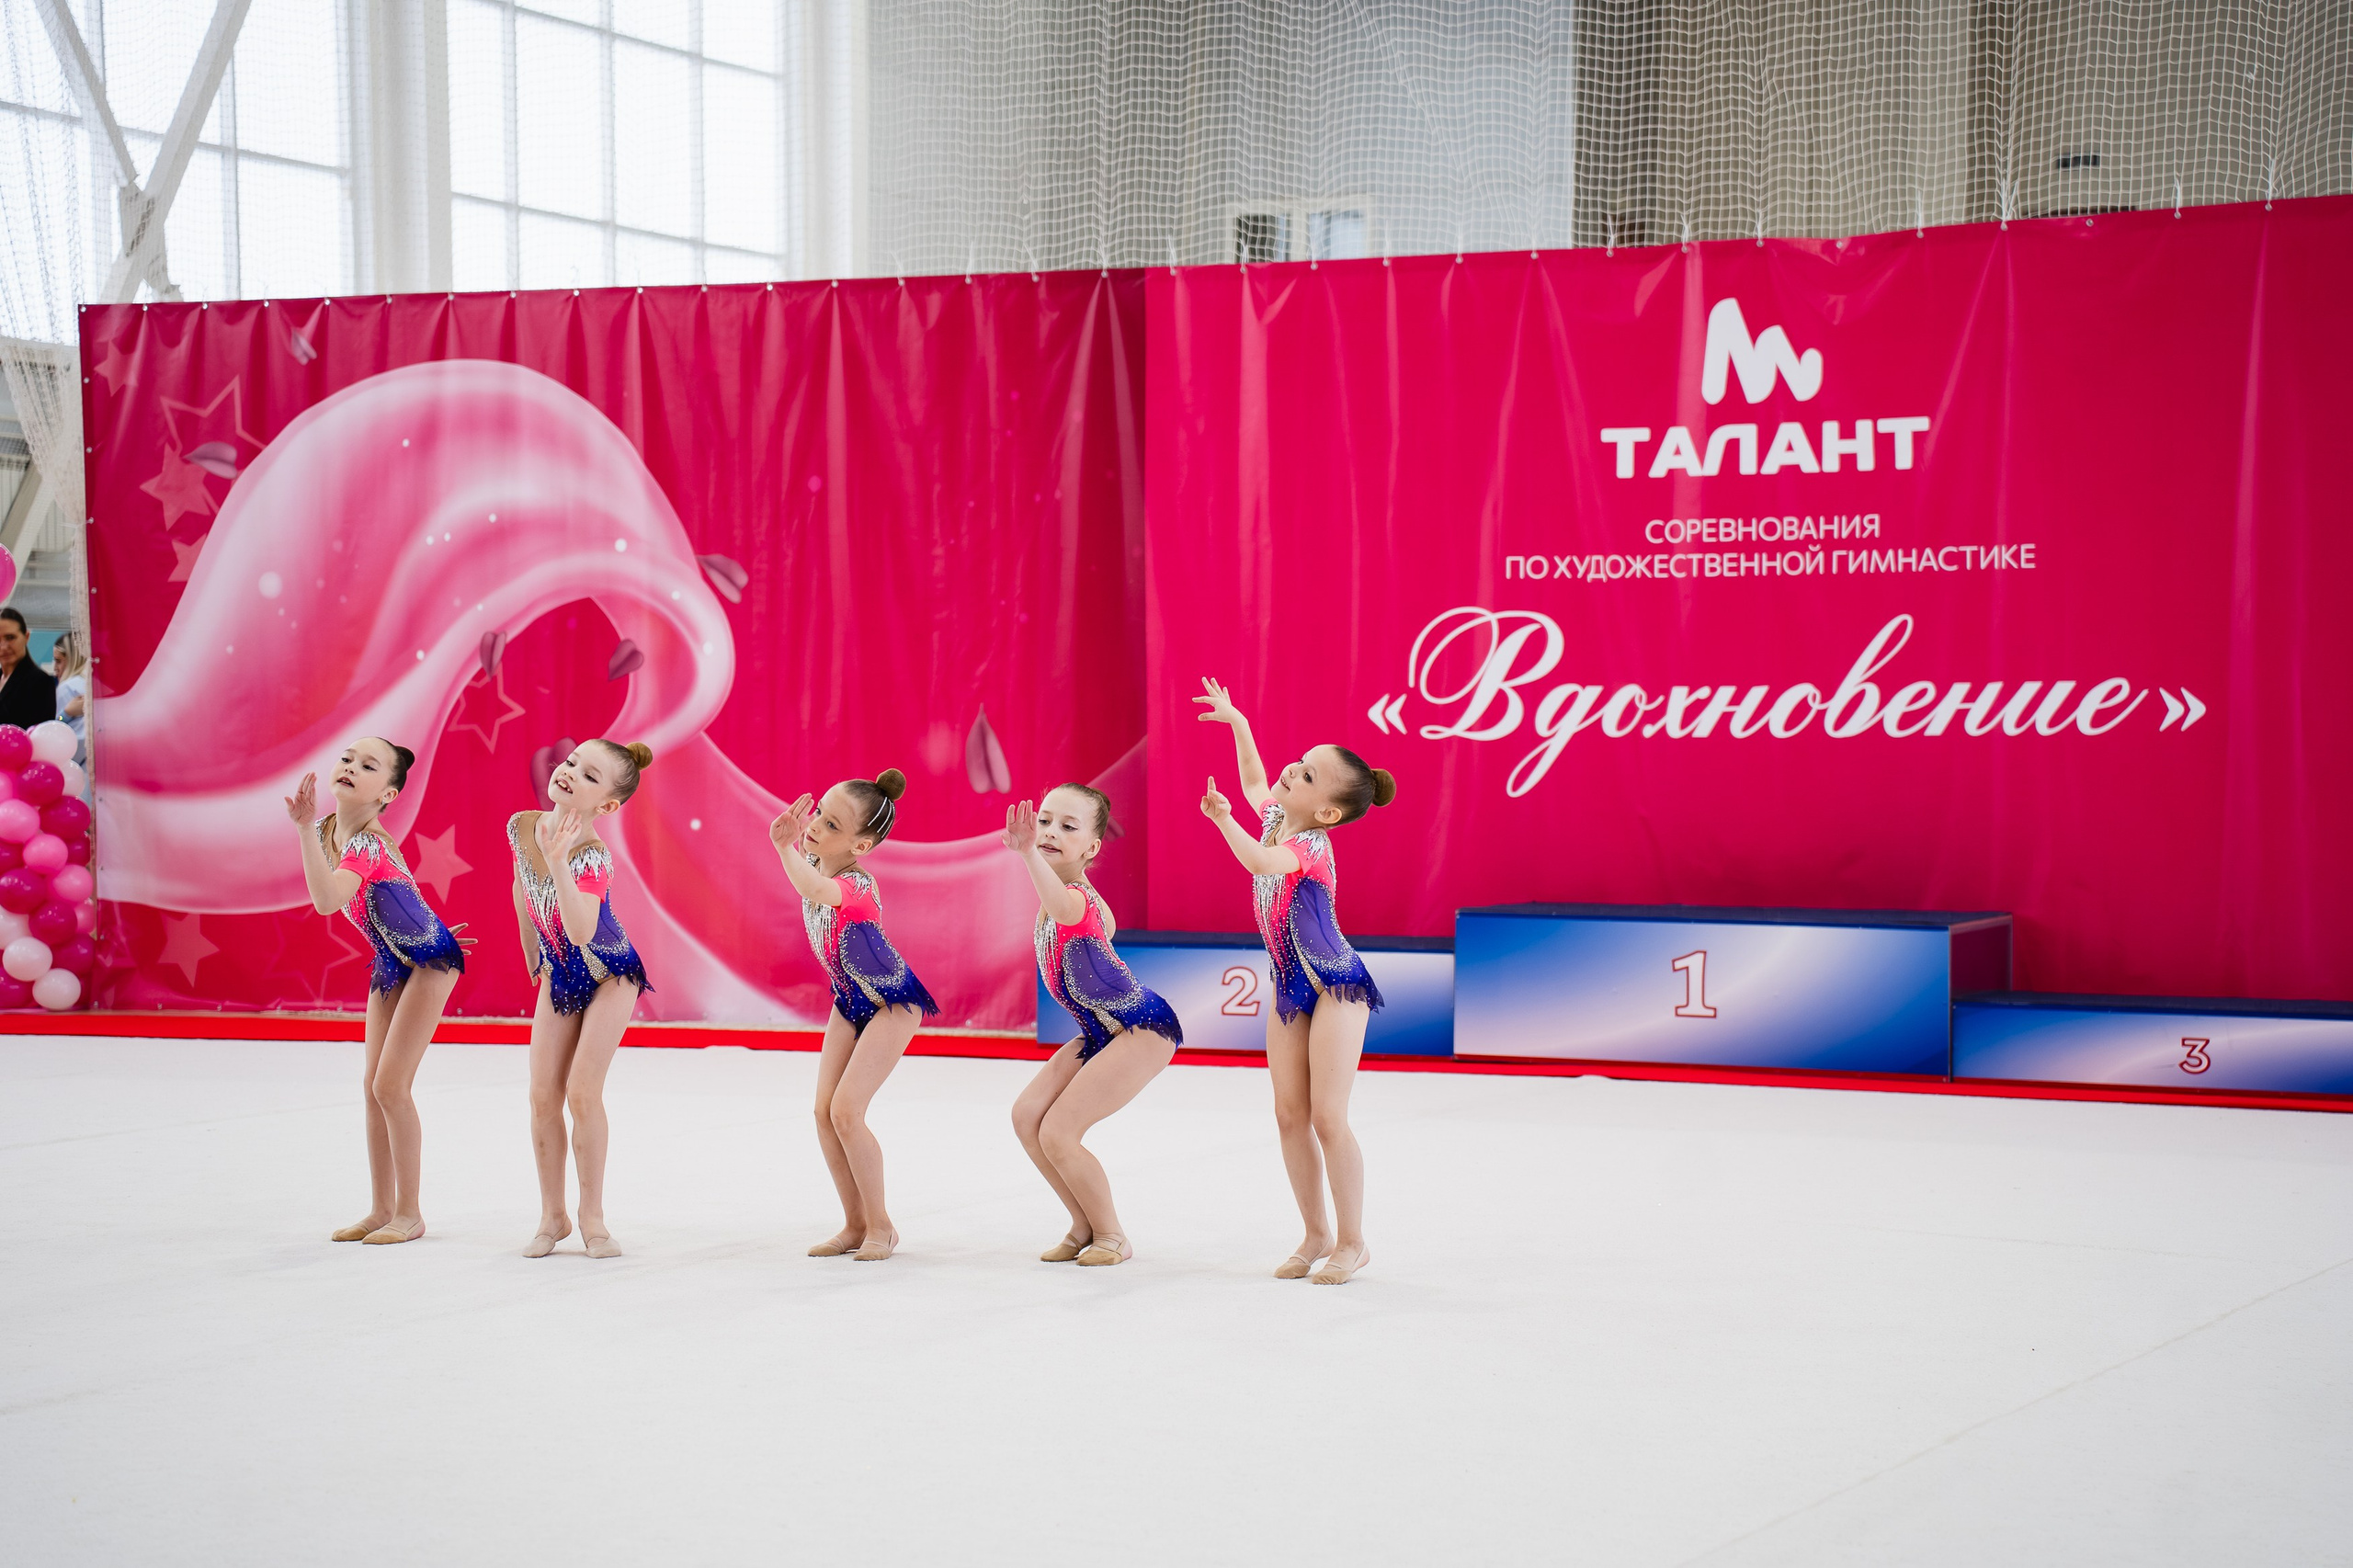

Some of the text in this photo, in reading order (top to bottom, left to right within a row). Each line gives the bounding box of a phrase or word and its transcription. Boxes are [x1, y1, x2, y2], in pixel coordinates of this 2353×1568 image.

[1600, 416, 1930, 479] ТАЛАНТ
[1645, 514, 1881, 544] СОРЕВНОВАНИЯ
[1506, 543, 2035, 583] ПО ХУДОЖЕСТВЕННОЙ ГИМНАСТИКЕ
[1221, 965, 1262, 1017] 2
[1671, 949, 1717, 1018] 1
[2178, 1036, 2212, 1076] 3
